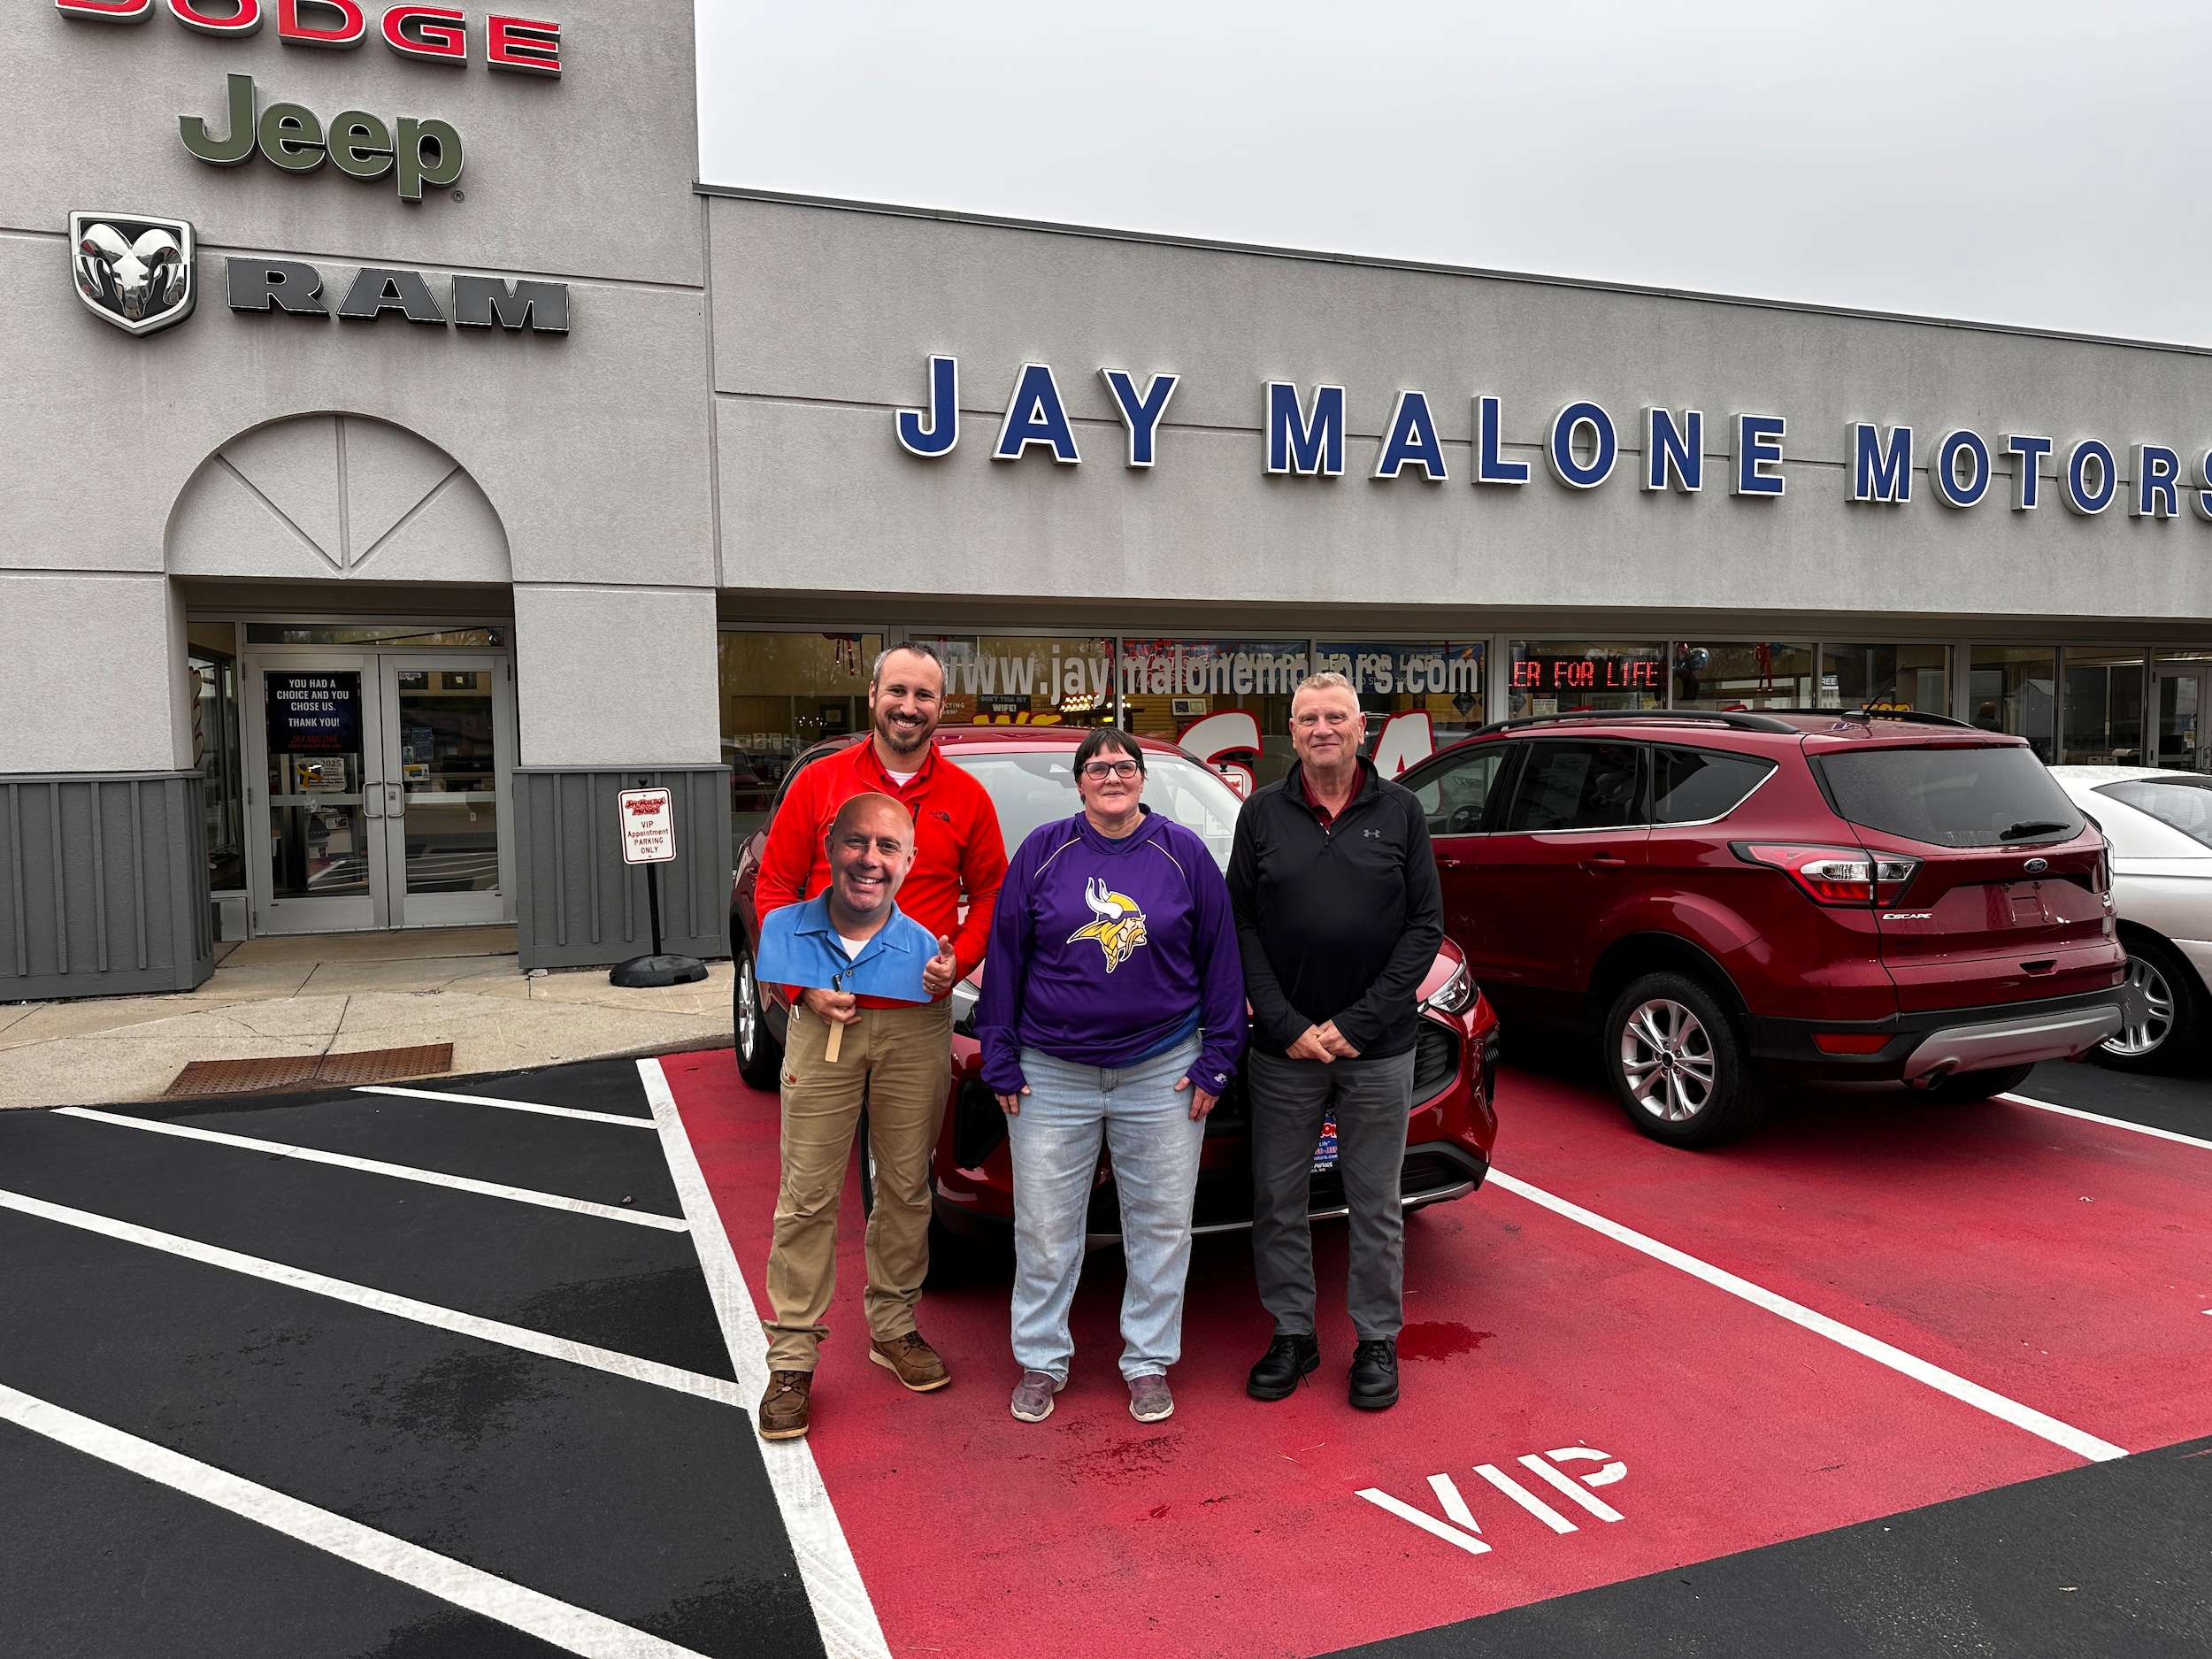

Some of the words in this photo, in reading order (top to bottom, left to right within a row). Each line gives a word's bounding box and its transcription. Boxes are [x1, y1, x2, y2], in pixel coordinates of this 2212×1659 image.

[226, 257, 569, 334] RAM
[895, 354, 1180, 468] JAY
[1261, 380, 1787, 496] MALONE
[1509, 662, 1540, 687] ER
[1554, 662, 1594, 687] FOR
[1607, 662, 1660, 687] LIFE
[288, 679, 307, 688] YOU
[309, 679, 327, 688] HAD
[330, 679, 336, 688] A
[276, 690, 309, 700] CHOICE
[311, 690, 329, 700] AND
[332, 690, 349, 700] YOU
[290, 702, 319, 711] CHOSE
[321, 702, 336, 711] US.
[992, 703, 1017, 712] WIFE!
[288, 718, 318, 727] THANK
[319, 718, 340, 727] YOU!
[306, 734, 338, 743] MALONE
[627, 828, 669, 838] Appointment
[634, 837, 664, 846] PARKING
[1354, 1446, 1628, 1555] VIP
